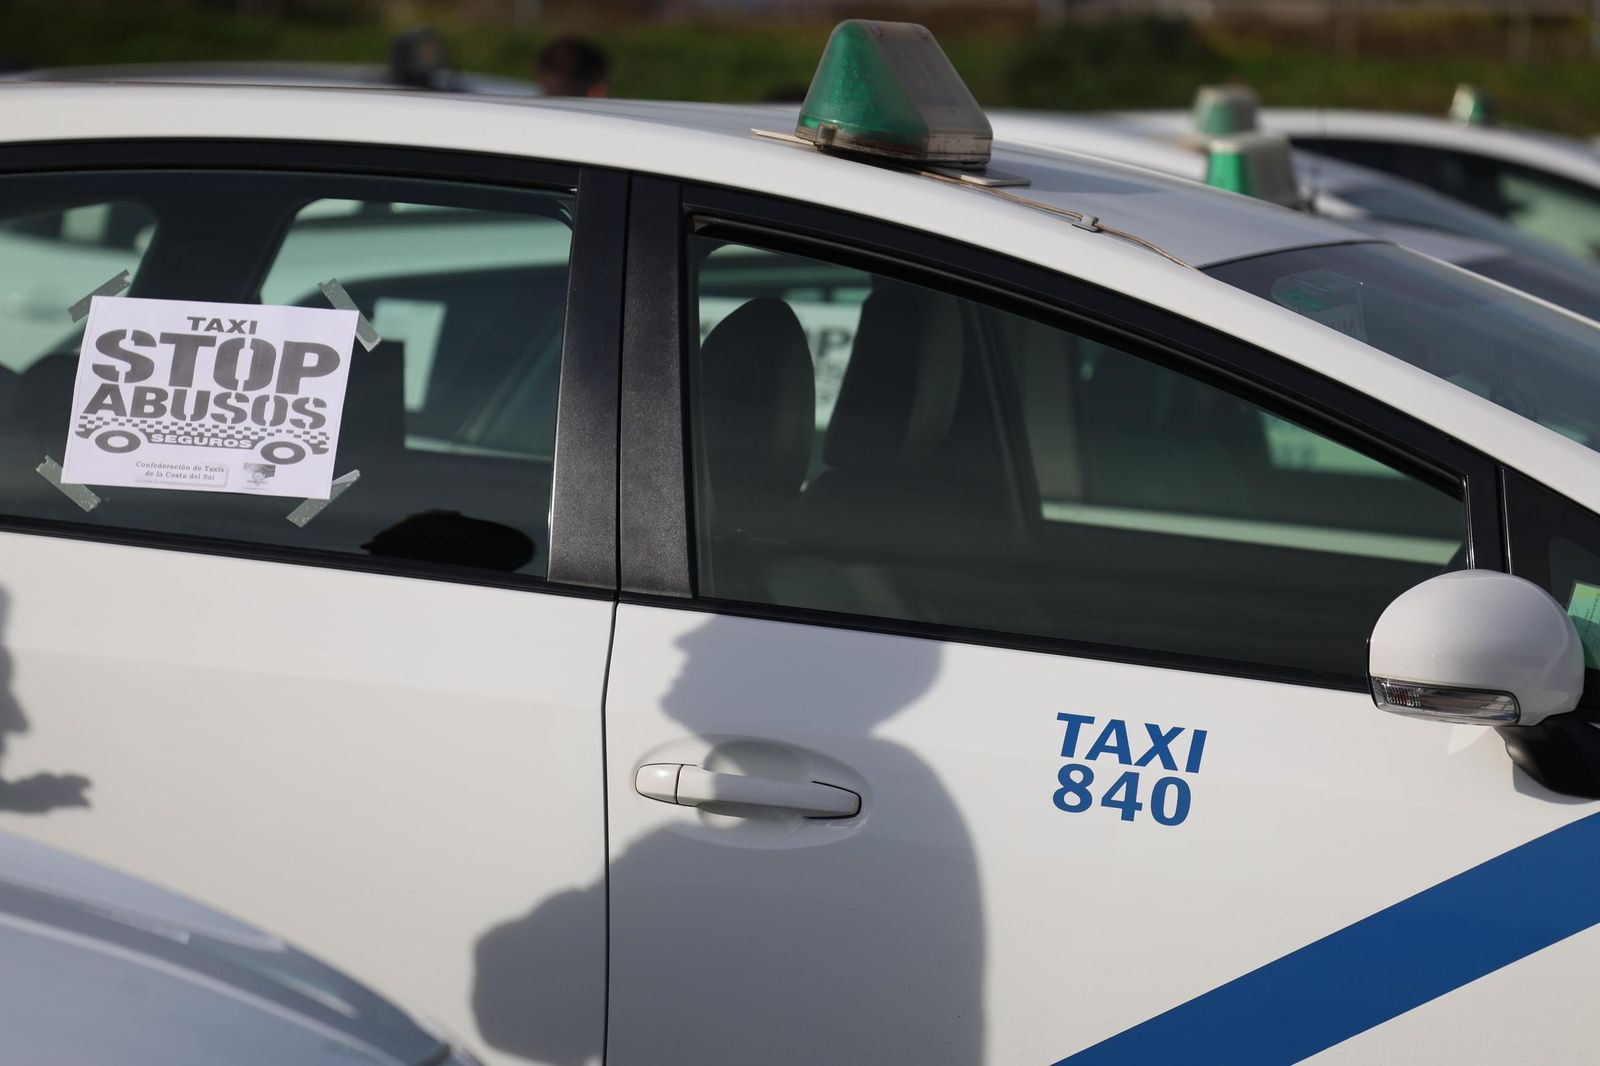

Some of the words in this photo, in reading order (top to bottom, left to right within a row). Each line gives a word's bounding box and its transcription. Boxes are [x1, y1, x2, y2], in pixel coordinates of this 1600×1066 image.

[187, 316, 257, 334] TAXI
[92, 329, 340, 395] STOP
[82, 383, 327, 429] ABUSOS
[151, 433, 252, 448] SEGUROS
[135, 461, 191, 471] Confederación
[192, 464, 201, 472] de
[204, 465, 225, 473] Taxis
[165, 471, 187, 479] Costa
[189, 472, 201, 480] del
[1056, 712, 1208, 774] TAXI
[1052, 763, 1191, 827] 840
